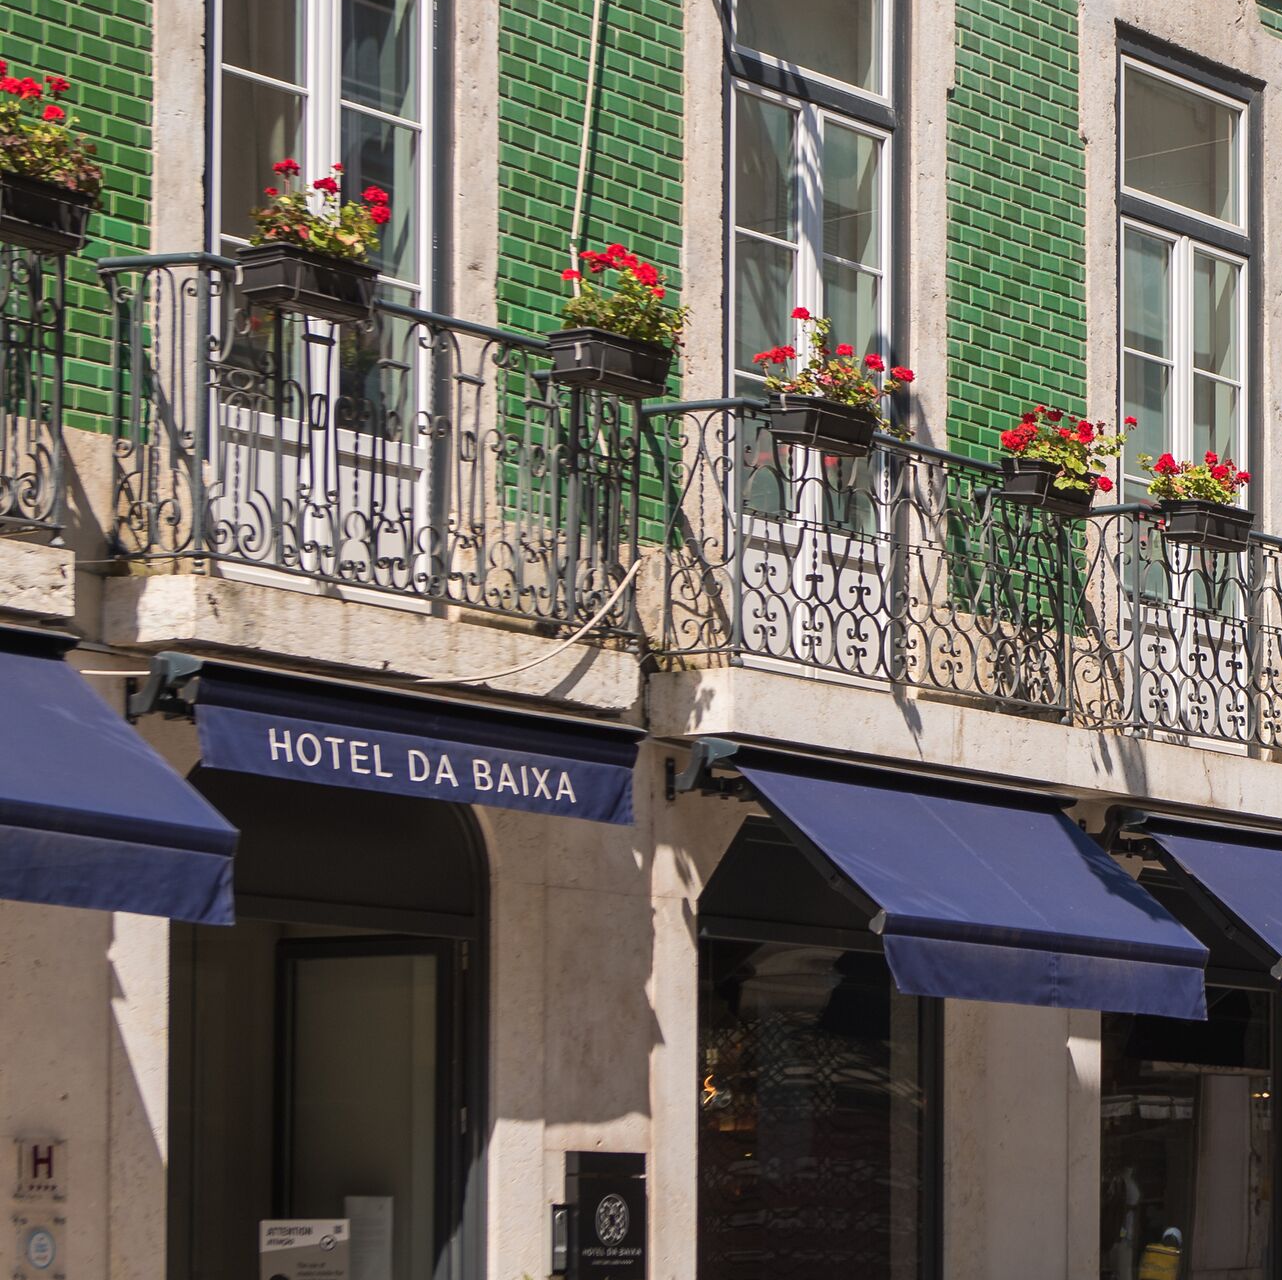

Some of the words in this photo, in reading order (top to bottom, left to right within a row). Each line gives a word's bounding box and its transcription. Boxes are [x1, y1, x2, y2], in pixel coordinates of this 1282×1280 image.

[268, 728, 393, 778] HOTEL
[408, 750, 459, 787] DA
[473, 759, 577, 803] BAIXA
[32, 1144, 54, 1179] H
